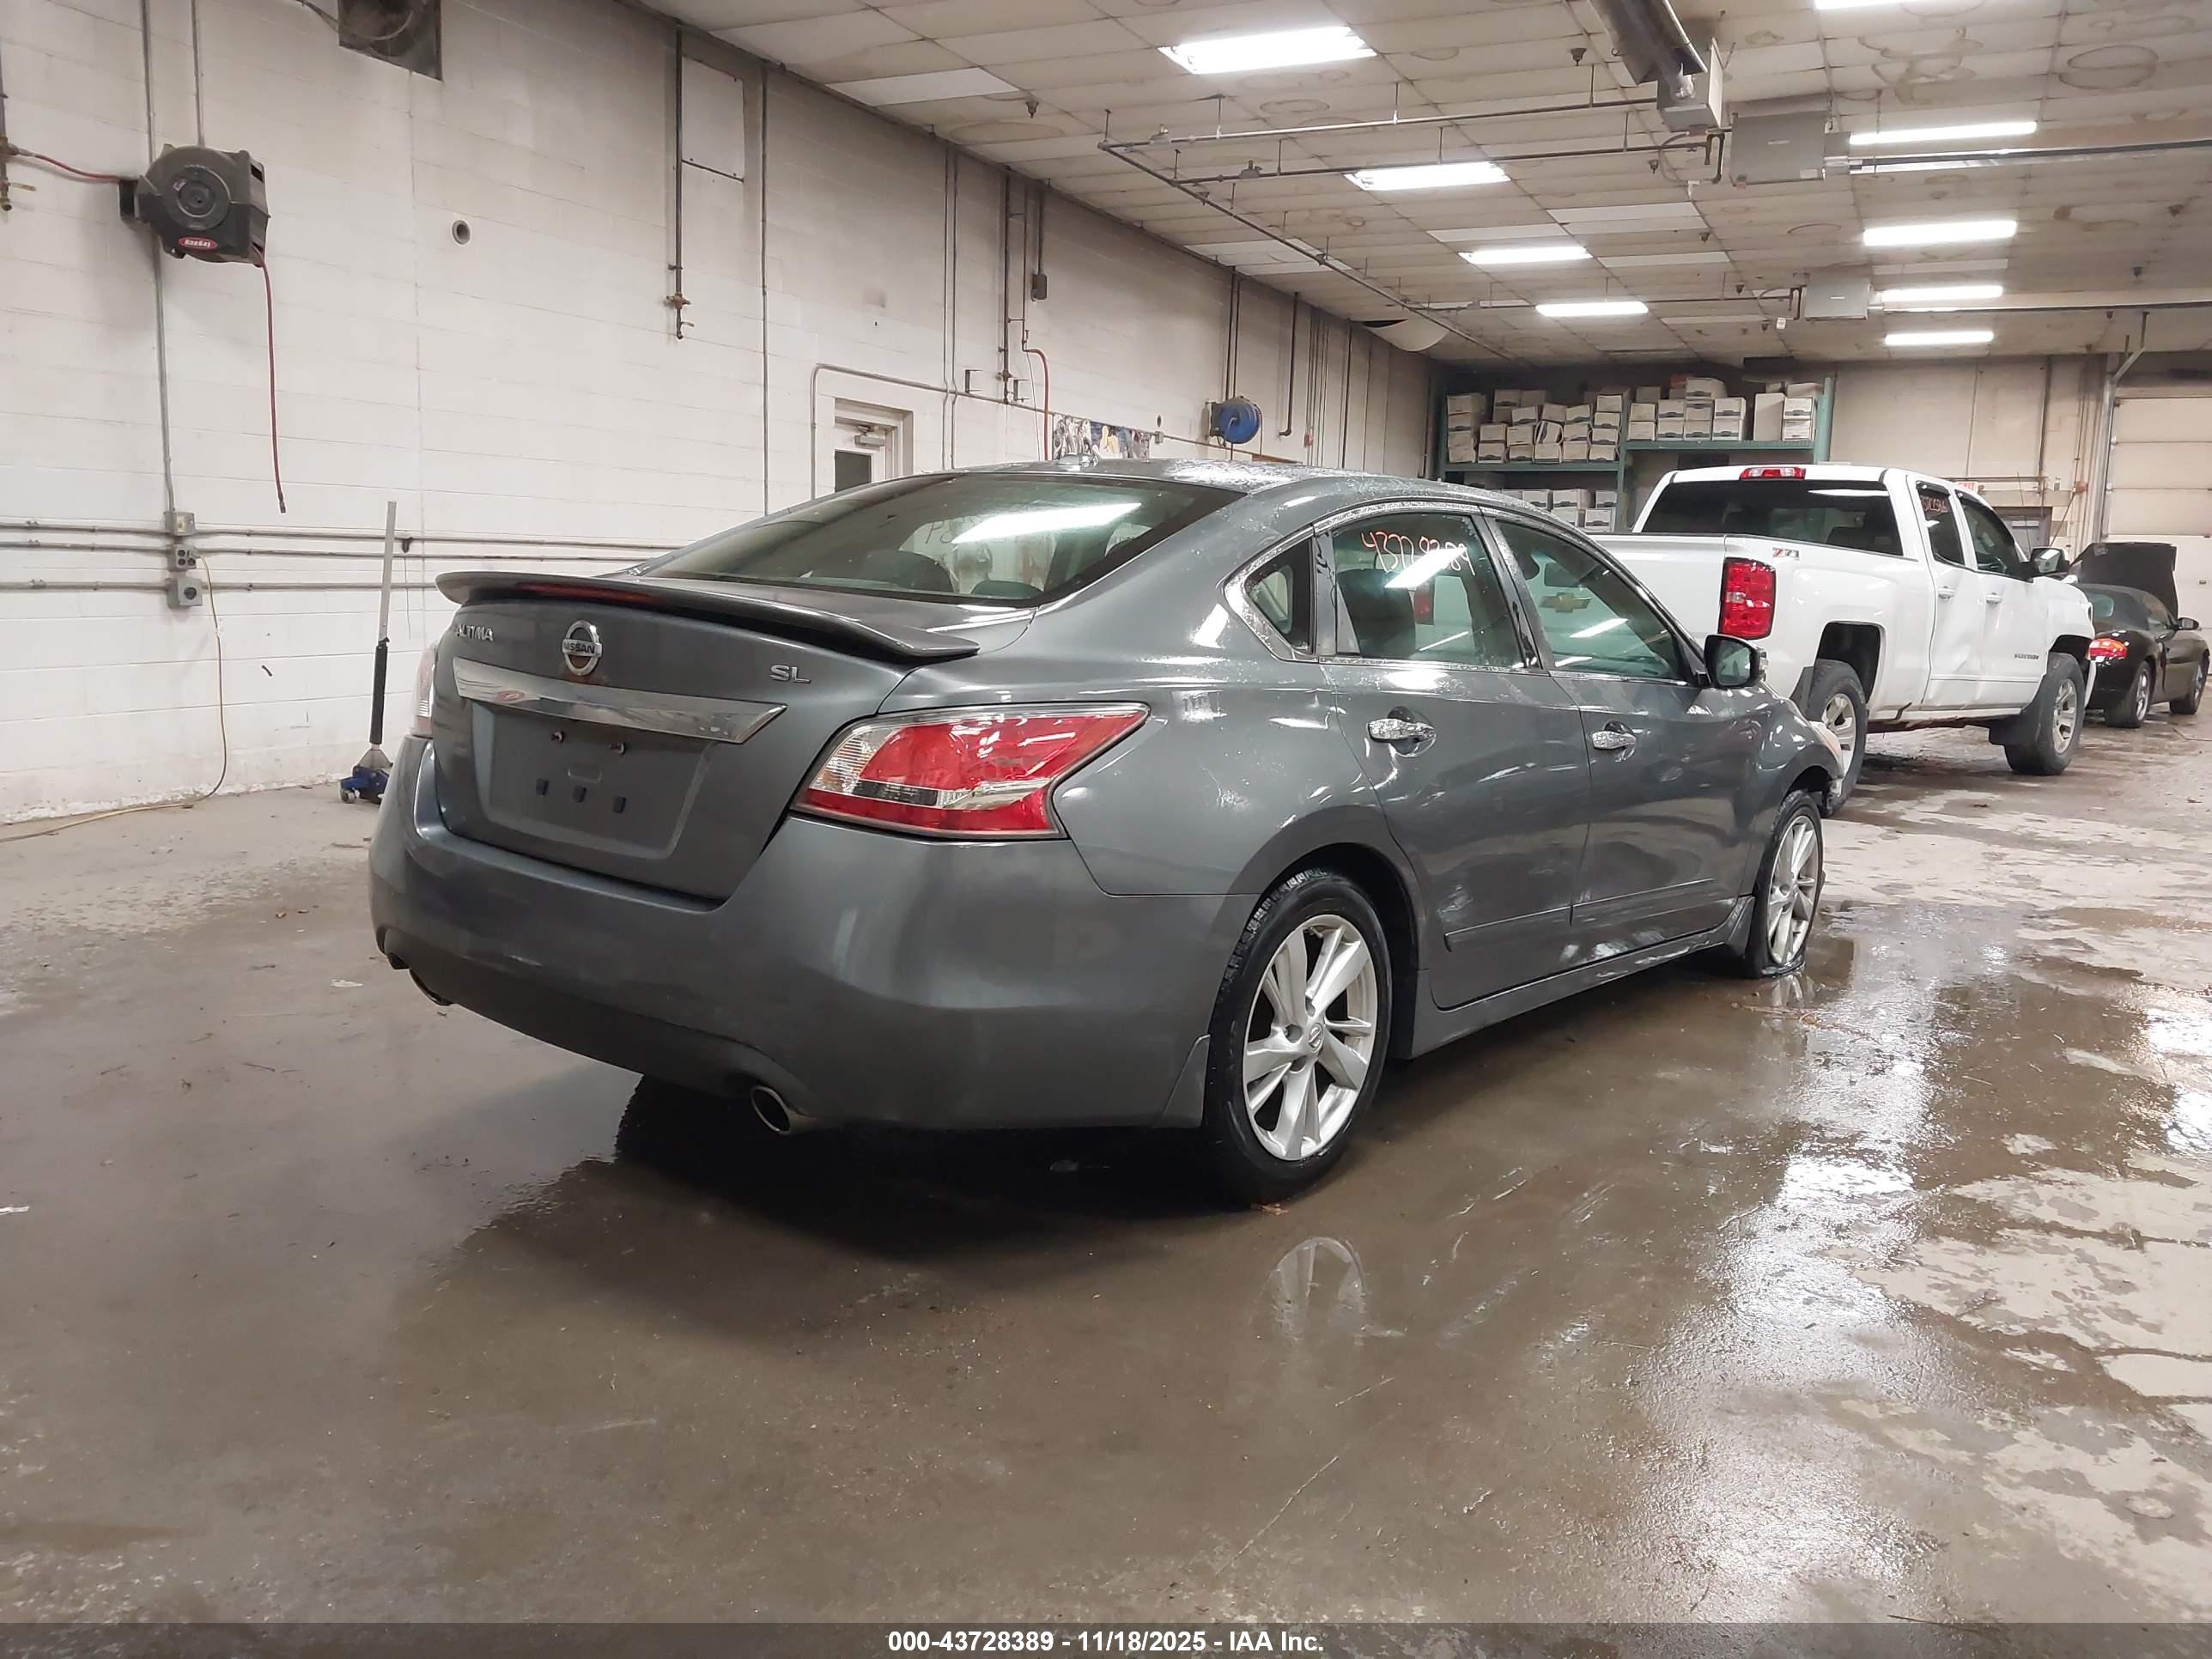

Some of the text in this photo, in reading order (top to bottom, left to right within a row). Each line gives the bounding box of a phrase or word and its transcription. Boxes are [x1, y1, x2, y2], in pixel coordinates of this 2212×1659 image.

[1772, 547, 1800, 561] Z71
[456, 624, 495, 642] ALTIMA
[563, 641, 596, 654] NISSAN
[769, 665, 811, 684] SL
